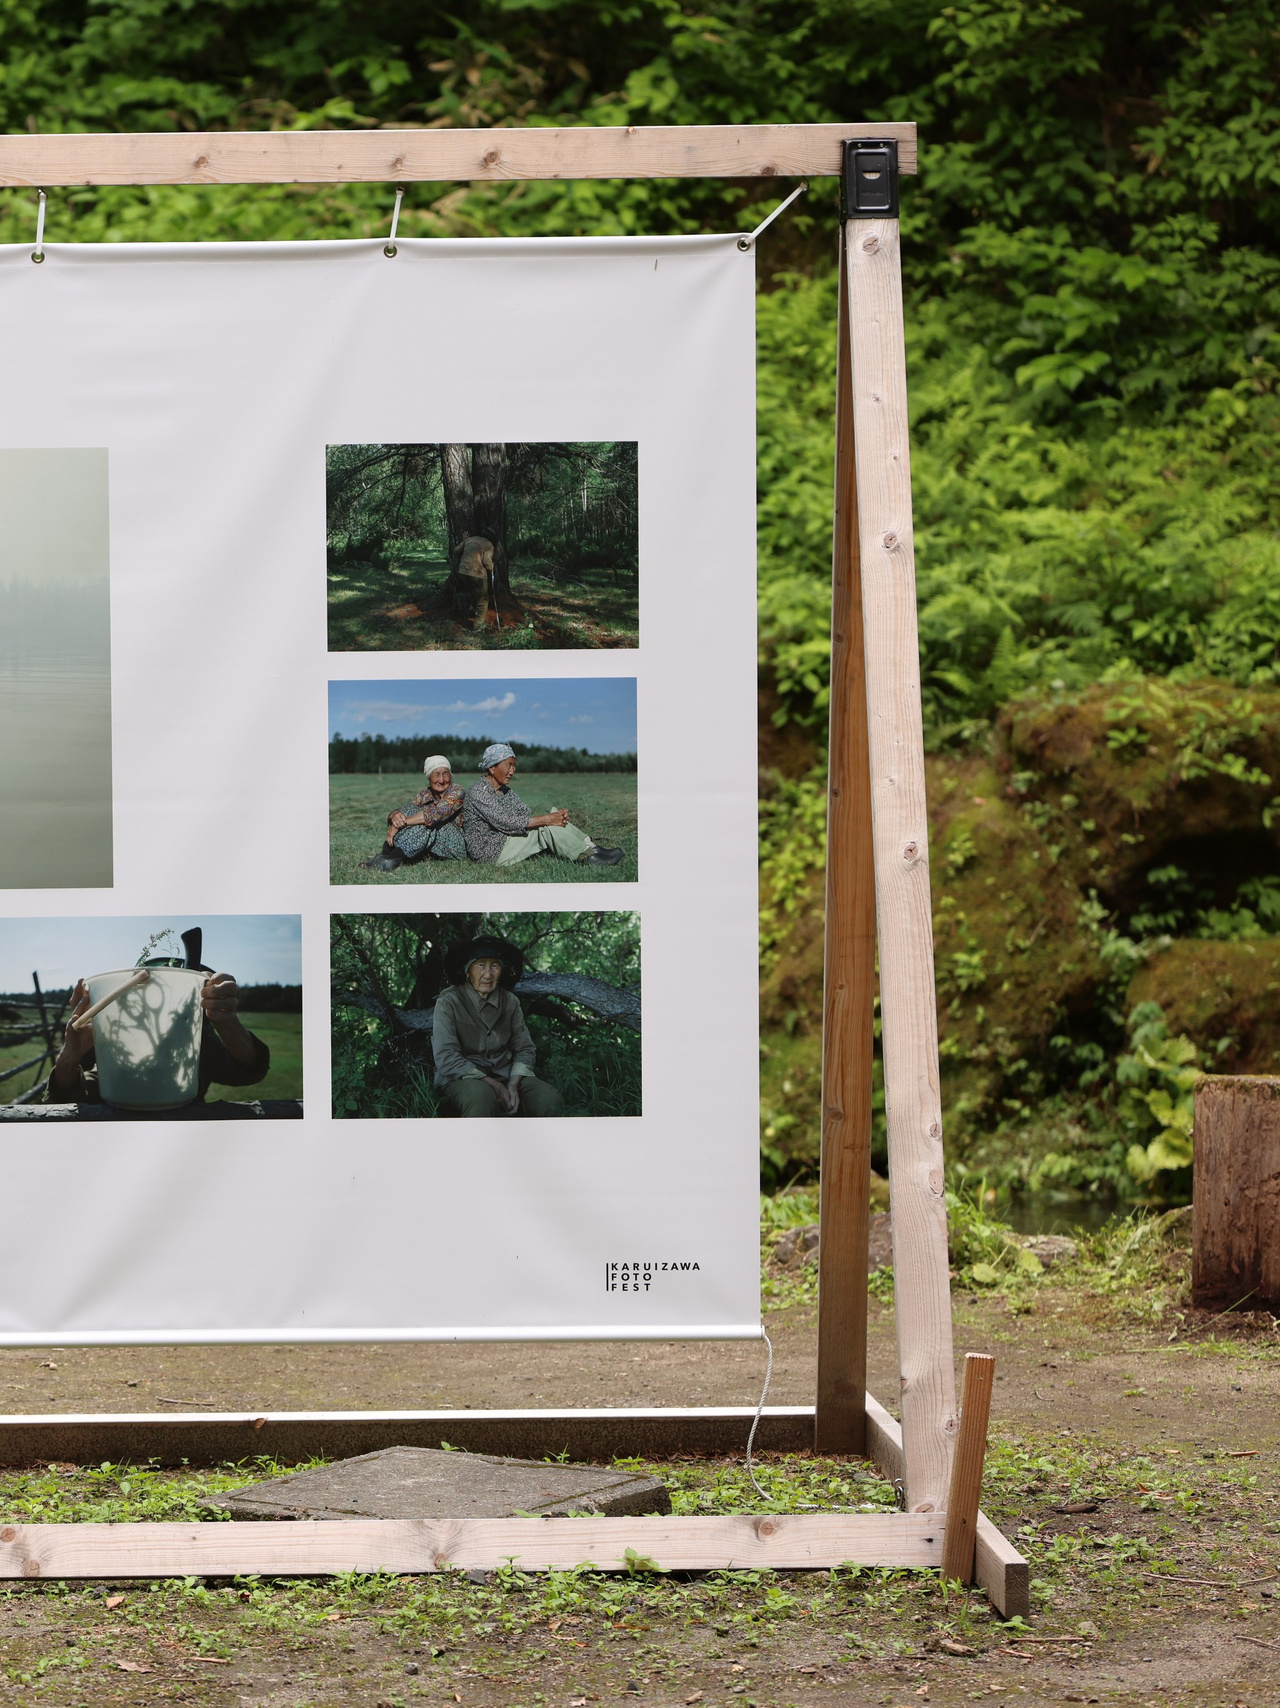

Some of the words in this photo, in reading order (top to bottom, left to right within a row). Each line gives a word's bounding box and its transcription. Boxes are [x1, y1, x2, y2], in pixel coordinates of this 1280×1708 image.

[611, 1262, 700, 1271] KARUIZAWA
[611, 1273, 652, 1281] FOTO
[611, 1283, 651, 1291] FEST
